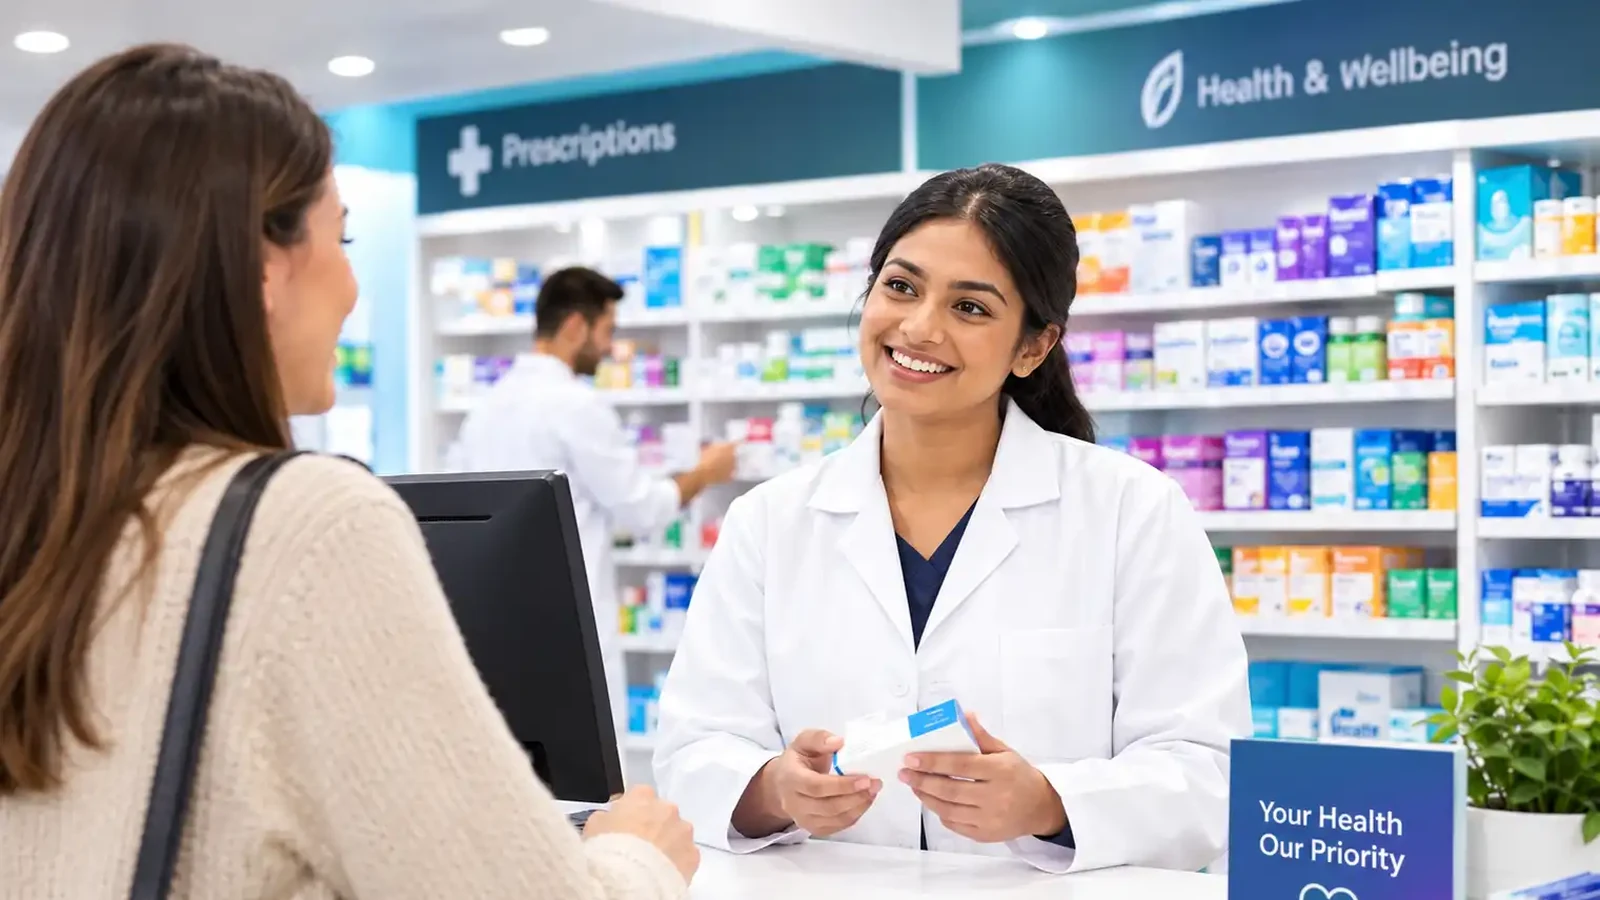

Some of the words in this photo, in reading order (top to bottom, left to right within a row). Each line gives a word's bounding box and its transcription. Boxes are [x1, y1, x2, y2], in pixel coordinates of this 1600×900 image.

[1197, 65, 1294, 107] Health
[1303, 60, 1328, 95] &
[1340, 40, 1508, 91] Wellbeing
[503, 119, 675, 166] Prescriptions
[1259, 800, 1312, 826] Your
[1319, 805, 1403, 836] Health
[1259, 833, 1304, 860] Our
[1311, 838, 1406, 878] Priority
